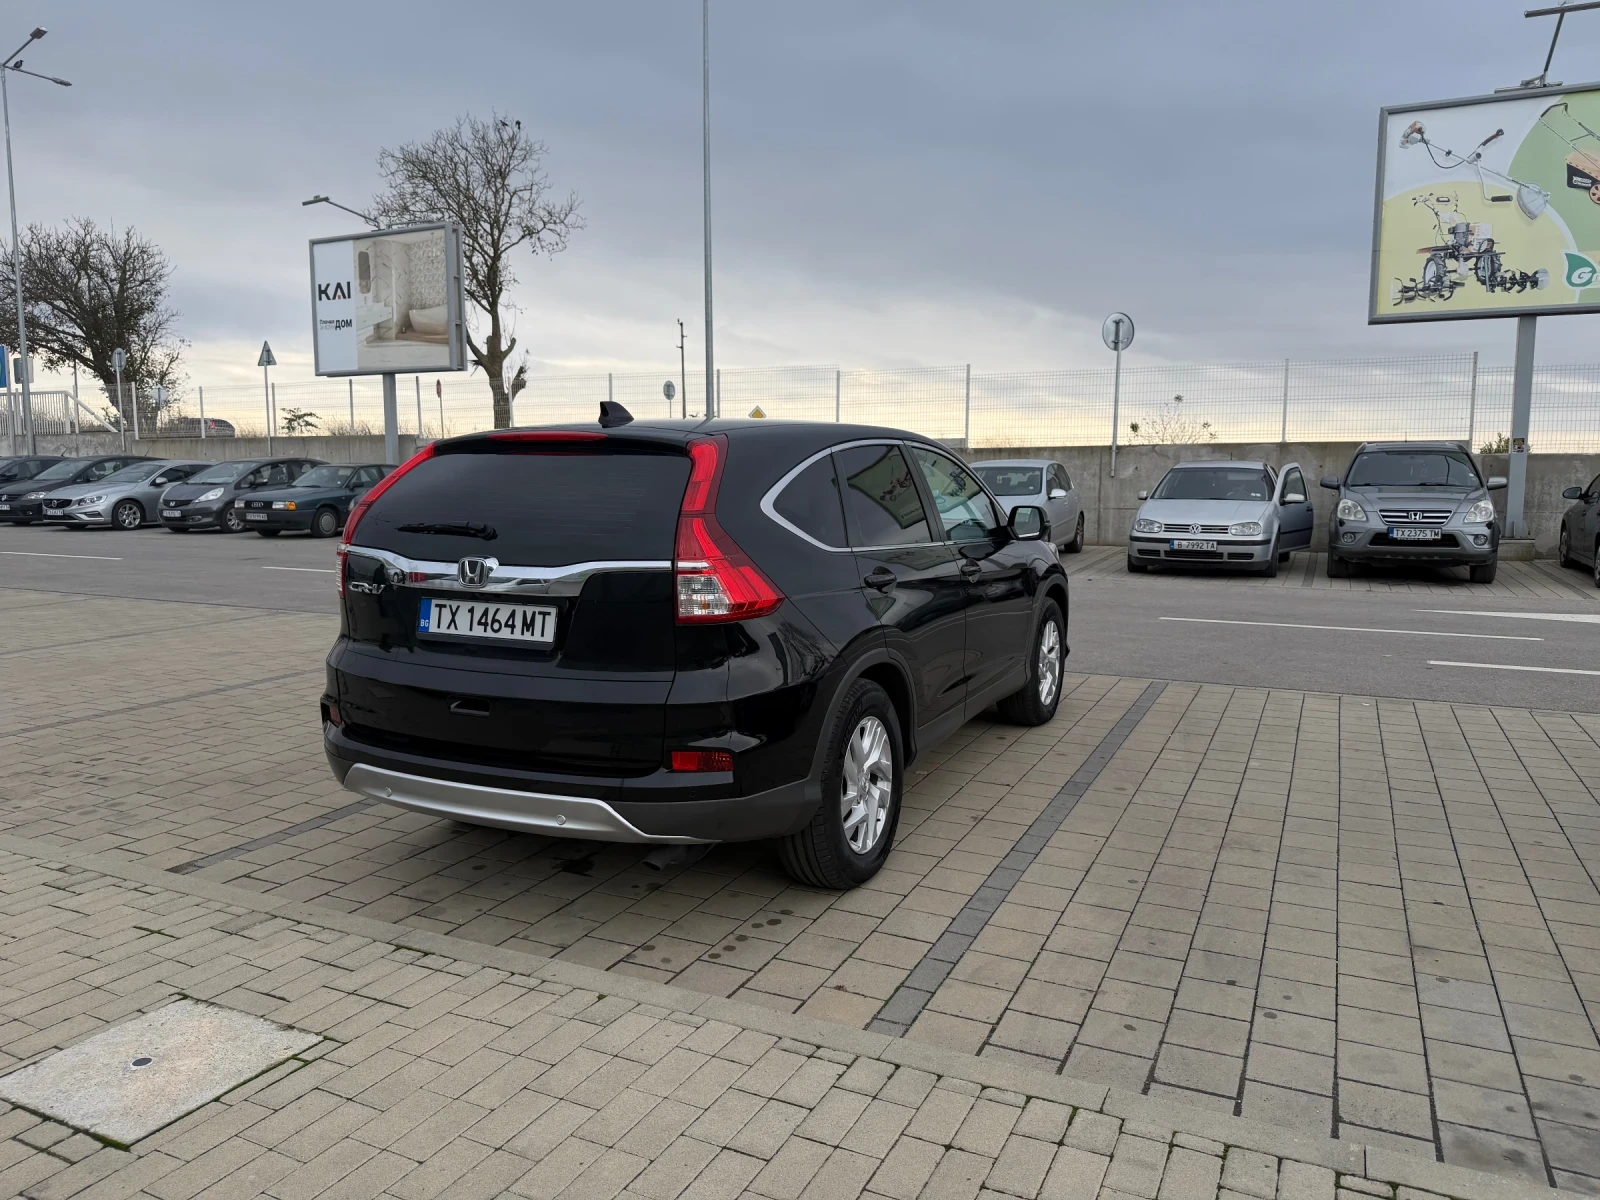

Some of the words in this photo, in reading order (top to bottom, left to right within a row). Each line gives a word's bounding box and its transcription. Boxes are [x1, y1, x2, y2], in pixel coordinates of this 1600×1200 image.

[318, 281, 351, 301] KAI
[335, 319, 352, 330] ДОМ
[1396, 529, 1406, 537] TX
[1407, 530, 1427, 538] 2375
[1429, 530, 1440, 538] TM
[1185, 541, 1204, 549] 7992
[1205, 542, 1216, 550] TA
[349, 582, 386, 595] CR-V
[420, 618, 430, 628] BG
[434, 603, 461, 631] TX
[467, 605, 517, 635] 1464
[521, 610, 552, 638] MT
